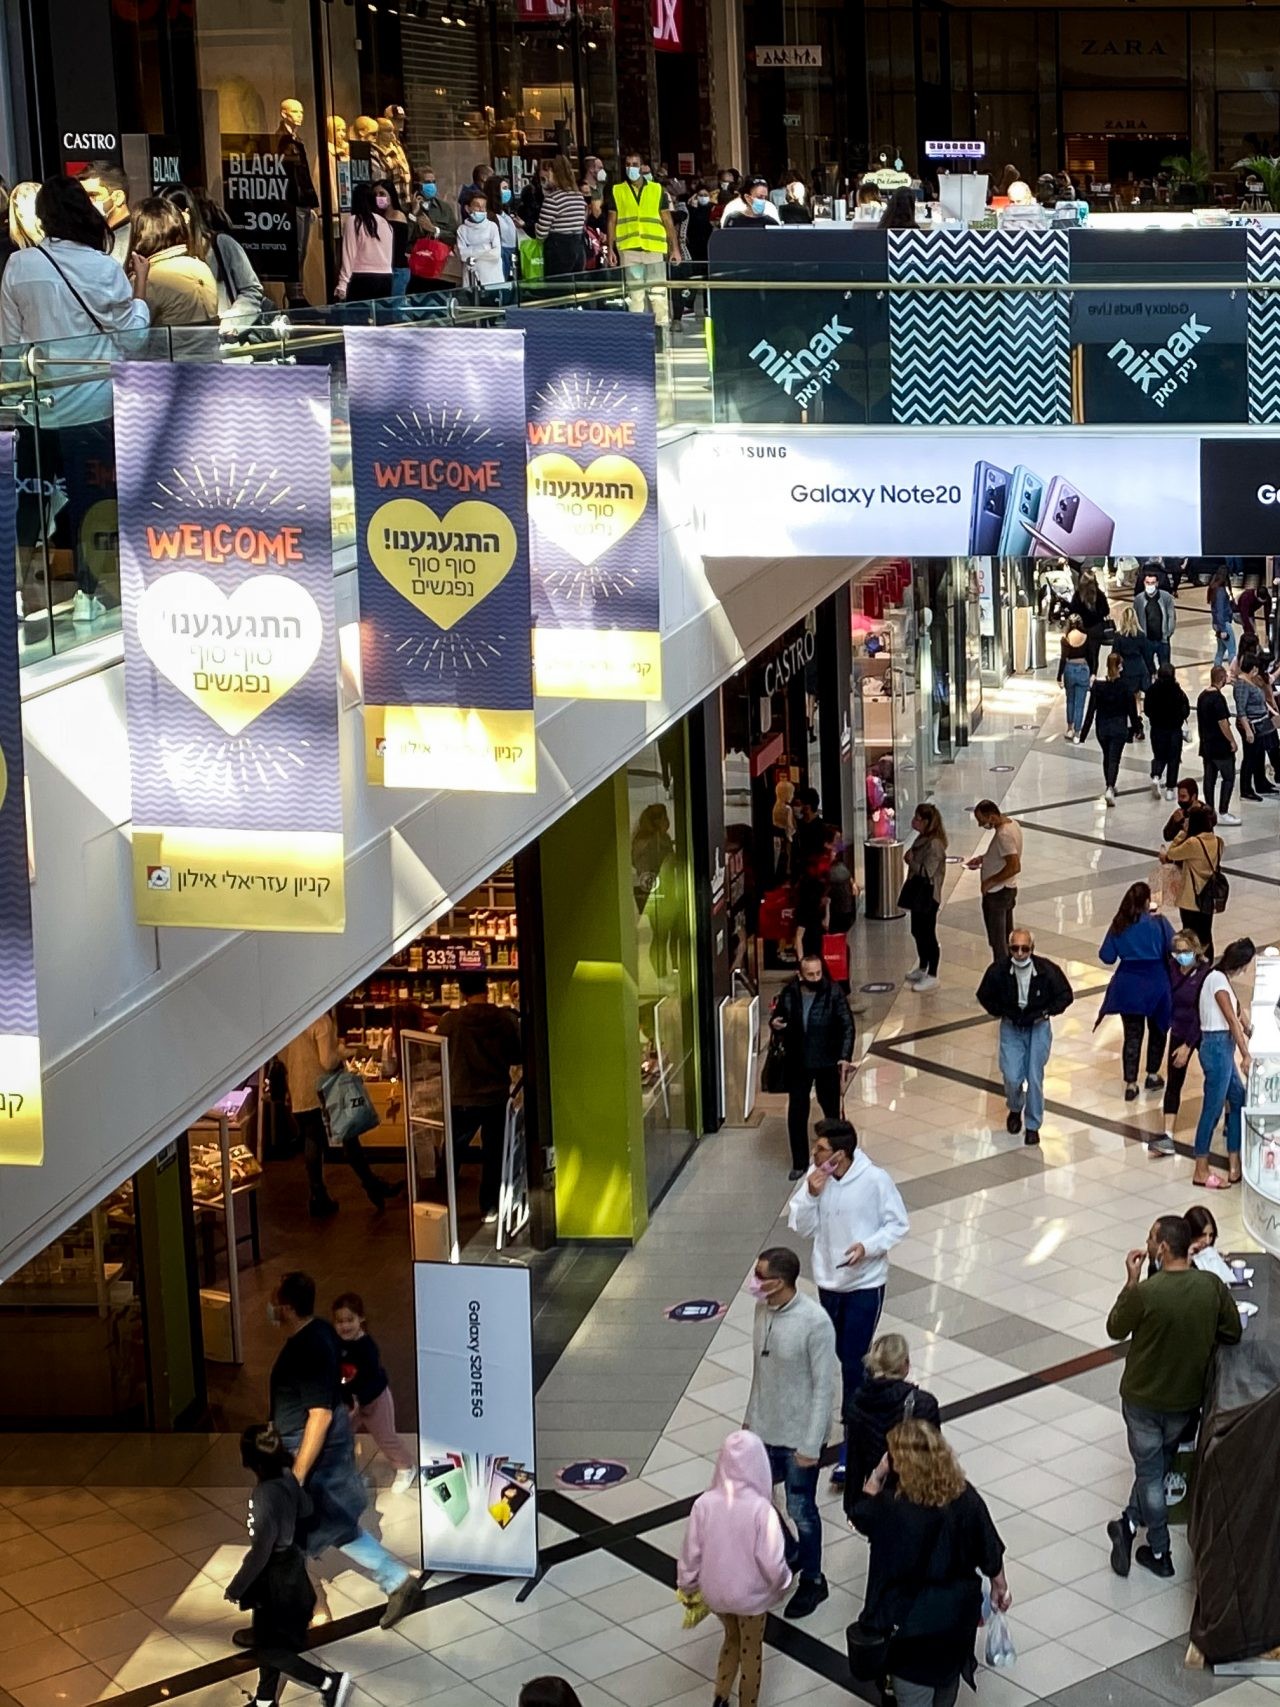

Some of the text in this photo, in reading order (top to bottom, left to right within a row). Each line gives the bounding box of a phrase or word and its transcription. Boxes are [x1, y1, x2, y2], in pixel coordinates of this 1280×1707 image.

[1081, 39, 1168, 55] ZARA
[1104, 120, 1148, 129] ZARA
[63, 133, 116, 149] CASTRO
[153, 156, 180, 182] BLACK
[229, 152, 287, 176] BLACK
[228, 177, 289, 200] FRIDAY
[244, 211, 292, 231] 30%
[527, 419, 636, 449] WELCOME
[373, 459, 502, 492] WELCOME
[535, 477, 634, 500] התגעגענו!
[791, 484, 962, 508] Galaxy Note20
[587, 504, 614, 520] סוף
[146, 523, 304, 566] WELCOME
[384, 527, 500, 553] התגעגענו!
[409, 557, 476, 577] סוף סוף
[412, 579, 474, 597] נפגשים
[764, 631, 816, 698] CASTRO
[193, 672, 271, 693] נפגשים
[494, 745, 523, 763] קניון
[177, 868, 331, 897] קניון עזריאלי אילון
[466, 1300, 484, 1418] Galaxy S20 FE 5G
